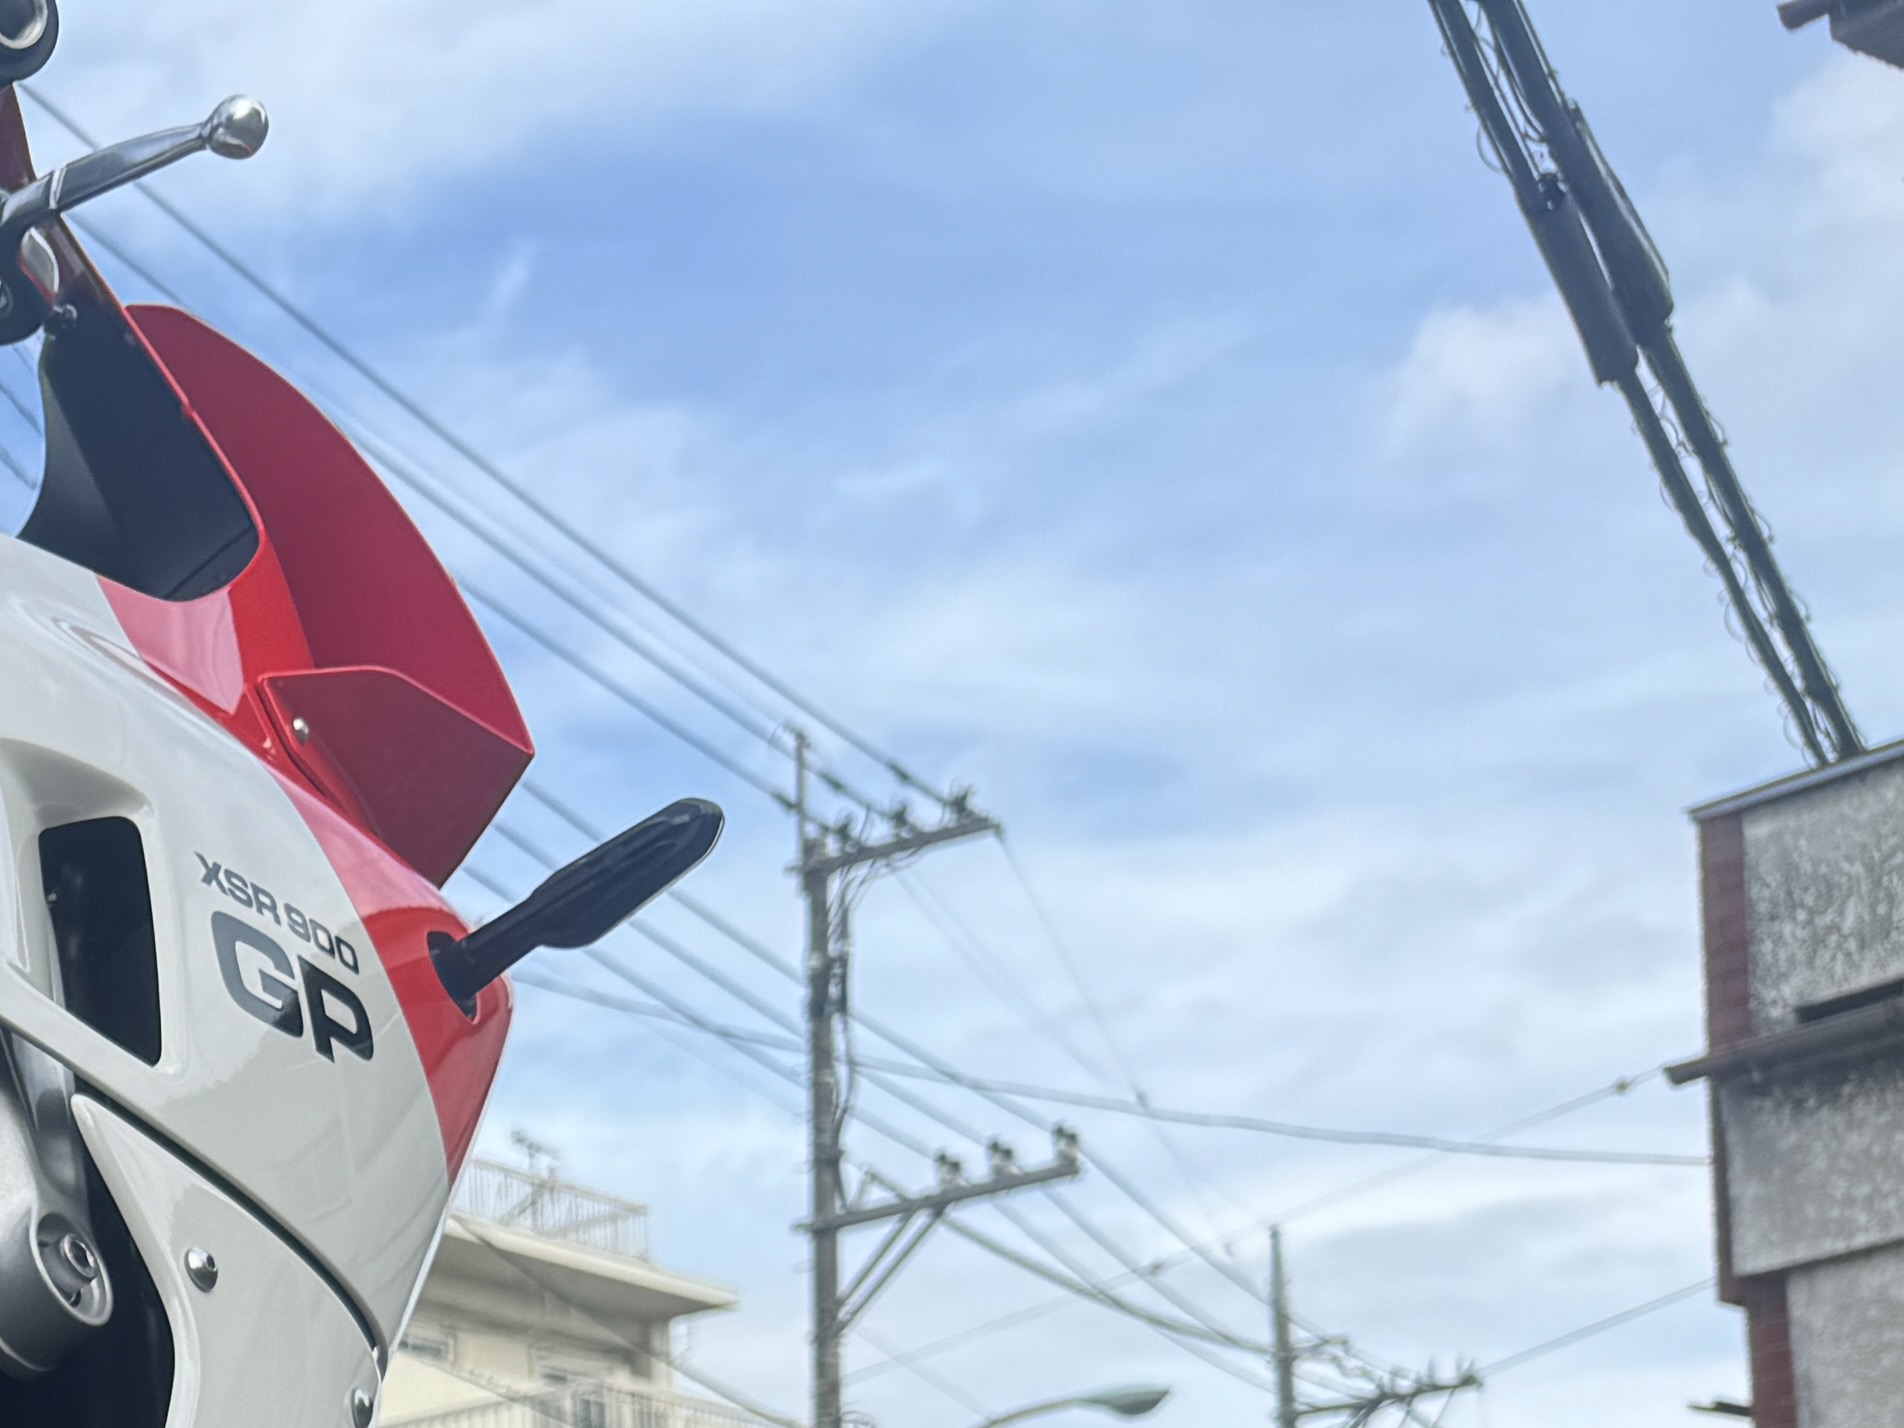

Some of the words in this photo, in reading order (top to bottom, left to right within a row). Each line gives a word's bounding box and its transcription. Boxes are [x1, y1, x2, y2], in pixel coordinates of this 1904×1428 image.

[193, 850, 282, 926] XSR
[284, 902, 359, 975] 900
[211, 911, 374, 1063] GP
